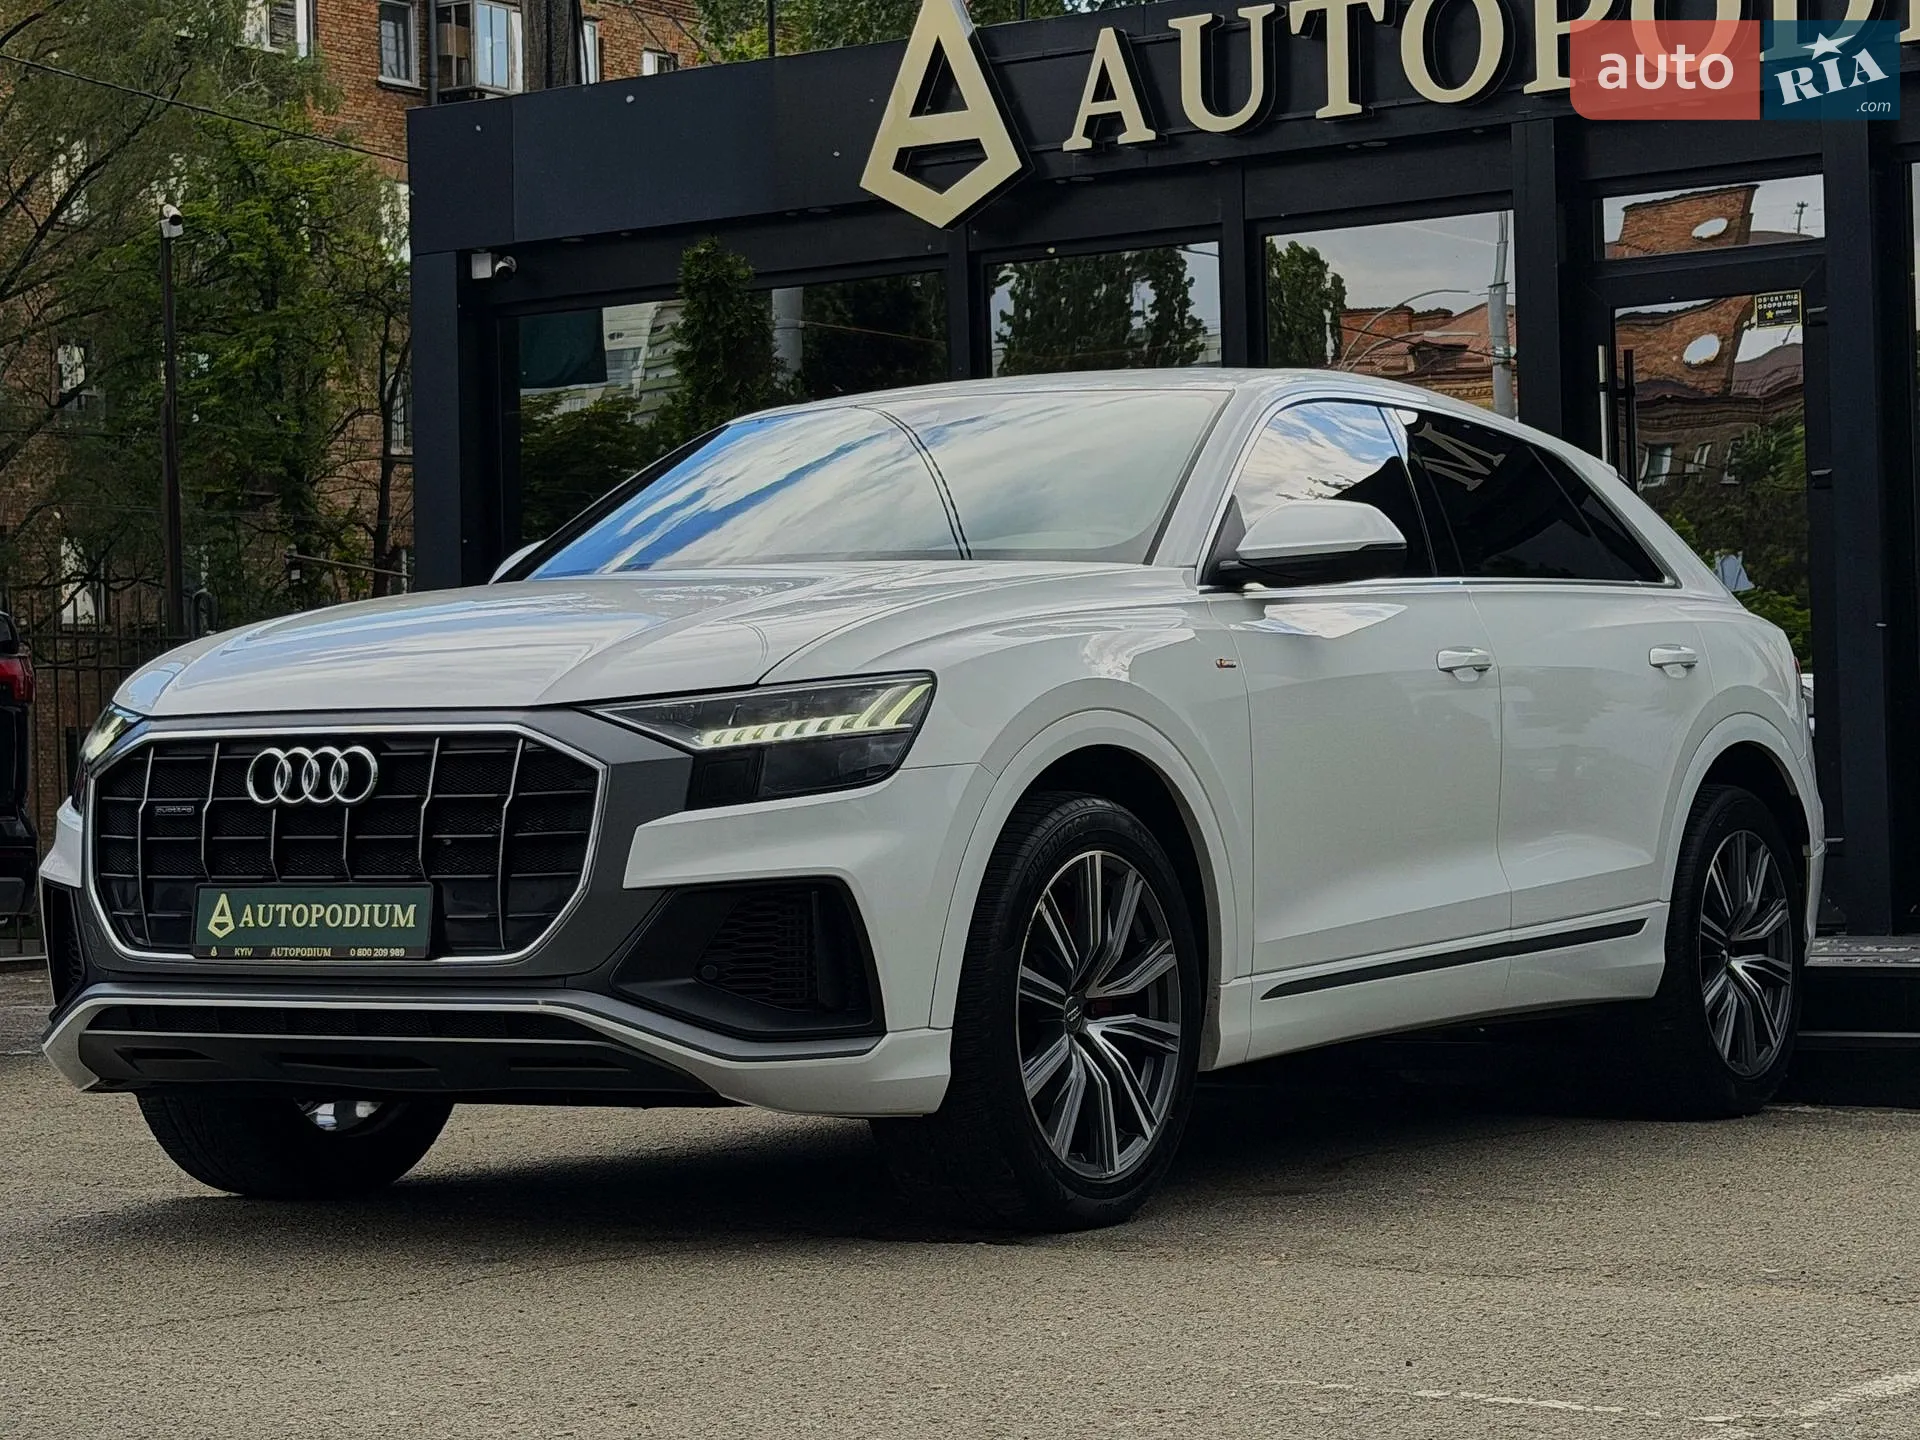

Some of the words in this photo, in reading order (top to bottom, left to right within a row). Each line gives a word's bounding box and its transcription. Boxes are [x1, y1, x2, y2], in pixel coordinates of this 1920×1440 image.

[238, 903, 417, 928] AUTOPODIUM
[234, 947, 253, 957] KYIV
[270, 947, 331, 957] AUTOPODIUM
[350, 948, 356, 957] 0
[357, 948, 372, 957] 800
[373, 948, 388, 957] 209
